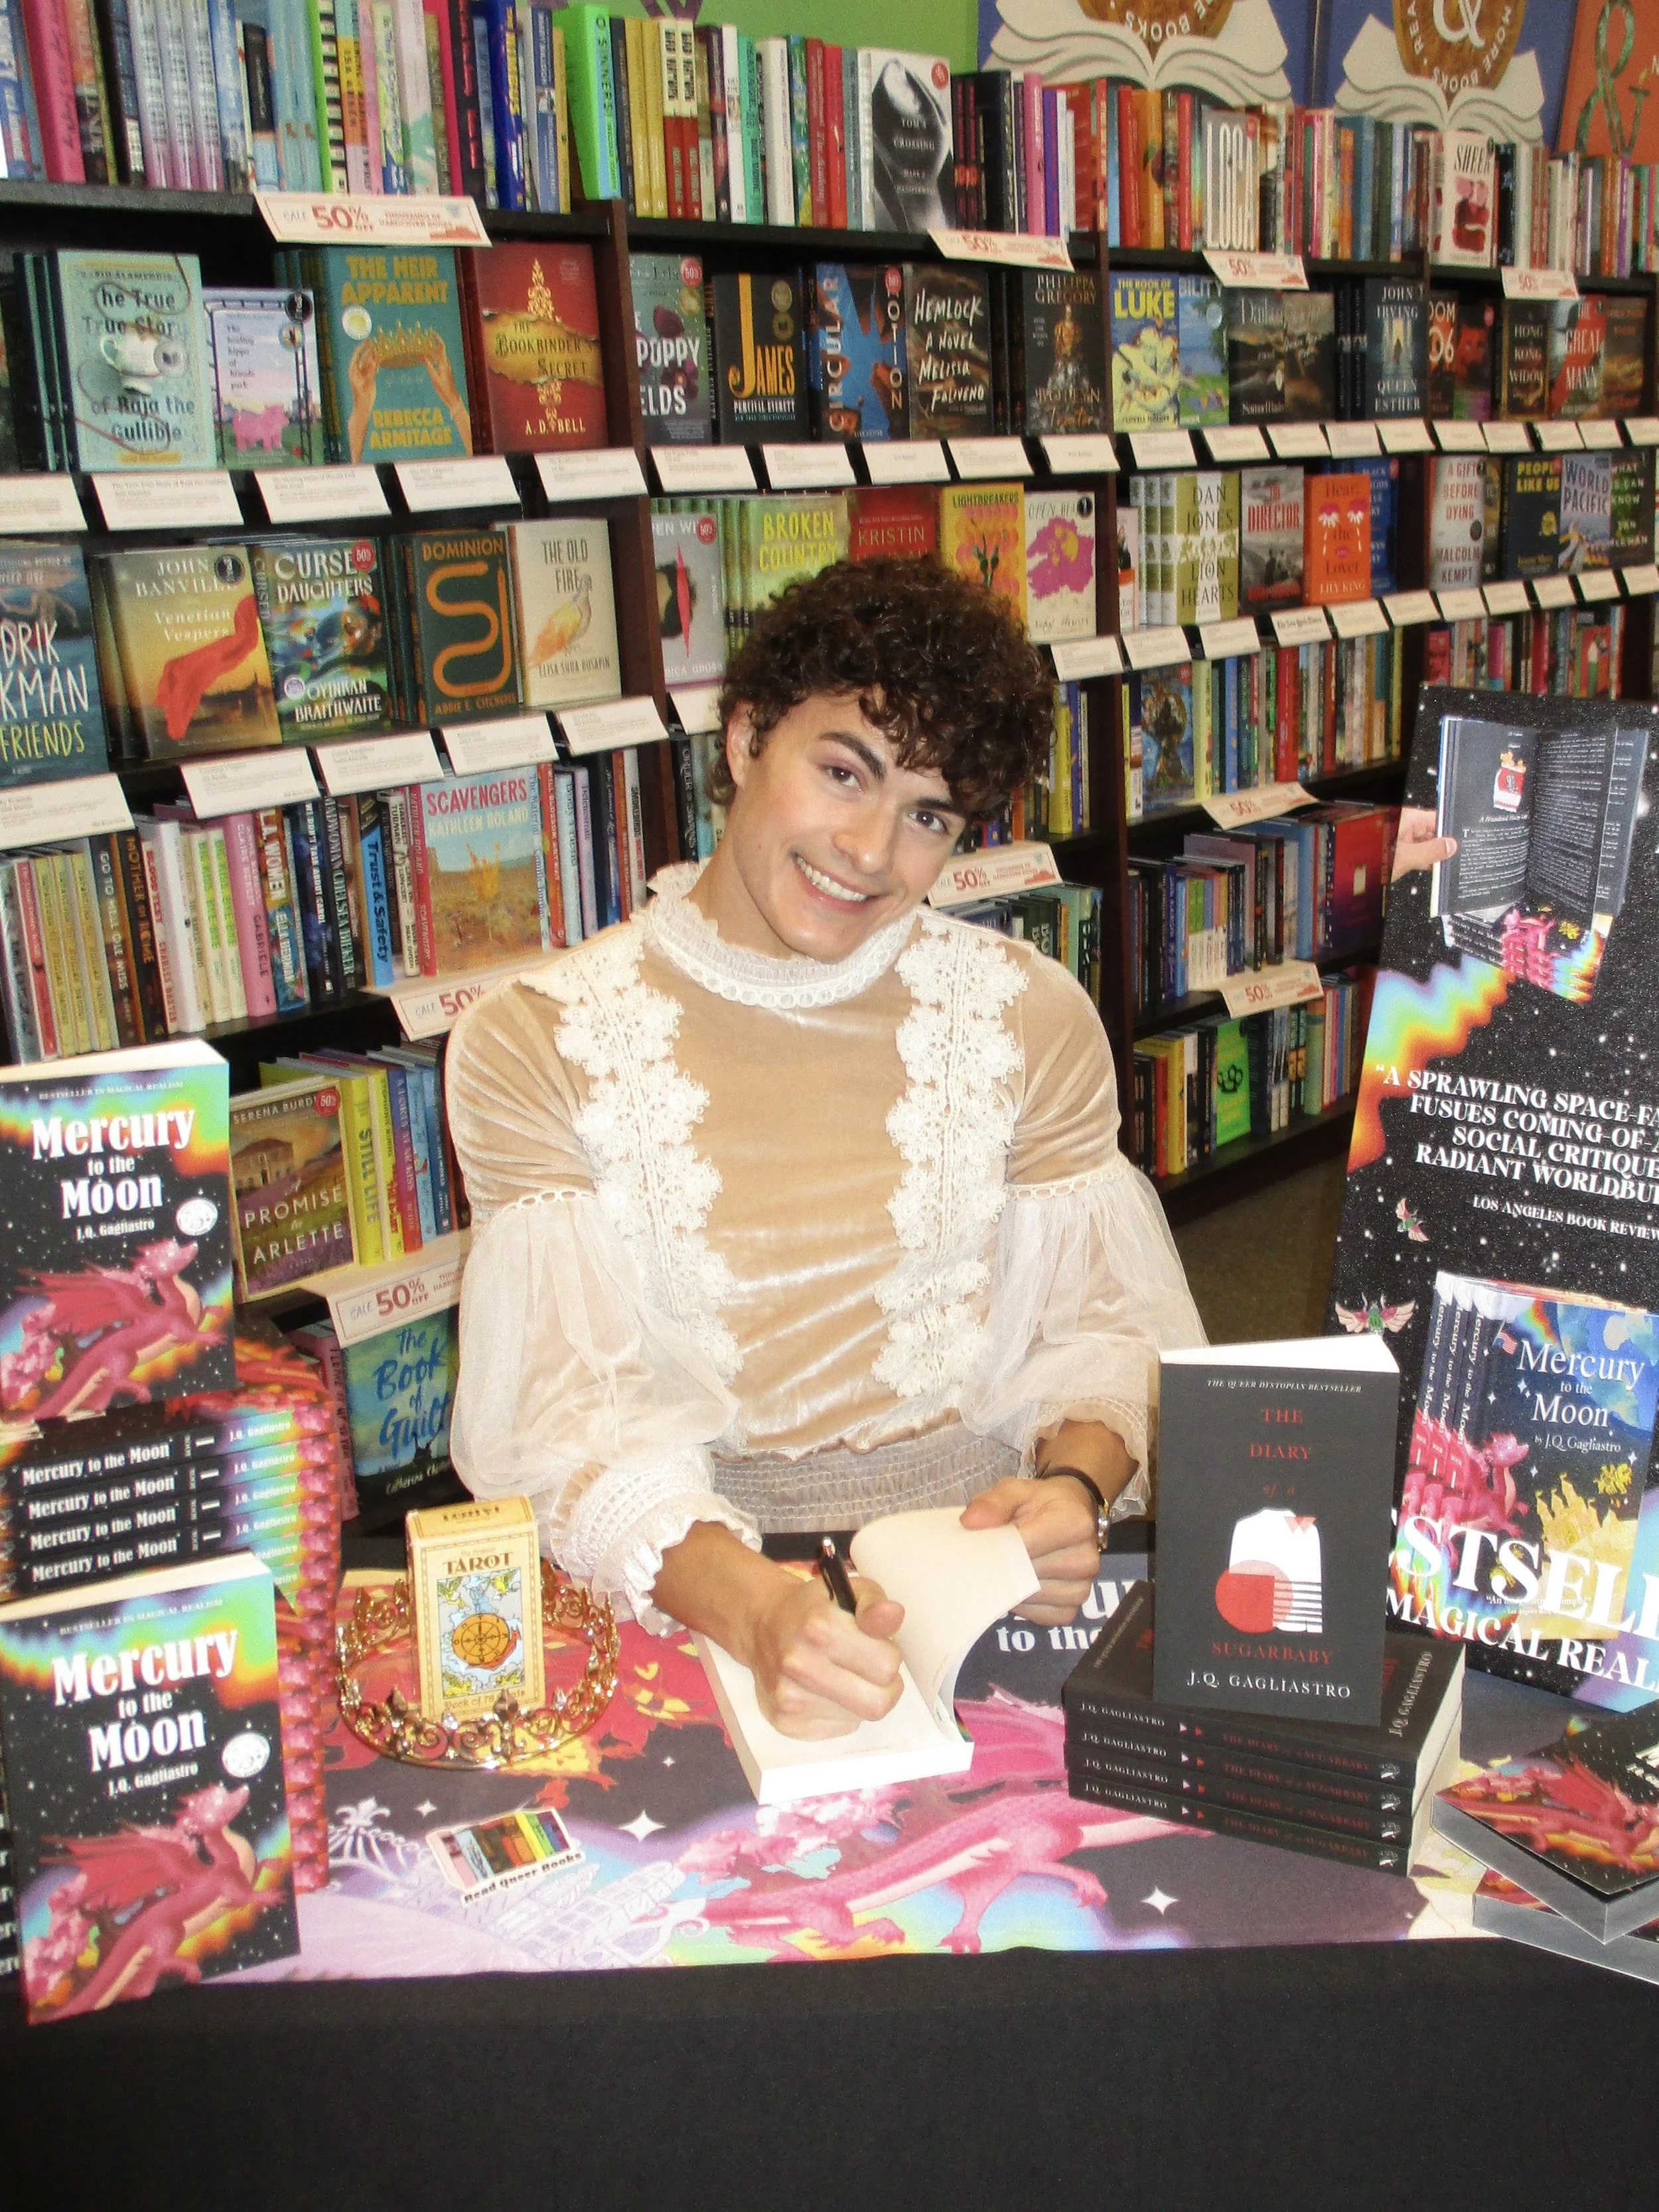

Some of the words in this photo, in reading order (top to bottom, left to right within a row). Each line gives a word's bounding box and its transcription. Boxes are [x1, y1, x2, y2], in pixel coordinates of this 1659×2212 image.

[346, 255, 388, 280] THE
[393, 255, 439, 280] HEIR
[341, 280, 449, 306] APPARENT
[1114, 288, 1176, 320] LUKE
[1382, 285, 1413, 302] JOHN
[913, 287, 984, 327] HEMLOCK
[1376, 304, 1419, 319] IRVING
[728, 271, 796, 399] JAMES
[925, 332, 933, 352] A
[939, 331, 975, 351] NOVEL
[636, 335, 701, 368] POPPY
[538, 357, 587, 378] SECRET
[1508, 369, 1544, 384] WIDOW
[1377, 378, 1418, 396] QUEEN
[166, 396, 196, 415] the
[372, 406, 443, 428] REBECCA
[1374, 397, 1421, 413] ESTHER
[111, 420, 182, 443] Gullible
[369, 426, 452, 450] ARMITAGE
[556, 418, 587, 434] BELL
[952, 492, 1019, 509] LIGHTBREAKERS
[1193, 484, 1226, 506] DAN
[1187, 509, 1234, 530] JONES
[1247, 503, 1300, 534] DIRECTOR
[1445, 504, 1475, 522] DYING
[762, 510, 835, 543] BROKEN
[857, 524, 925, 548] KRISTIN
[421, 536, 504, 562] DOMINION
[541, 539, 564, 565] THE
[566, 538, 589, 563] OLD
[758, 540, 839, 573] COUNTRY
[156, 558, 211, 577] JOHN
[273, 550, 359, 579] CURSE
[1190, 563, 1226, 581] LION
[277, 575, 374, 604] DAUGHTERS
[1181, 585, 1234, 608] HEARTS
[153, 608, 232, 626] Venetian
[163, 628, 230, 644] Vespers
[294, 693, 383, 722] BRAITHWAITE
[425, 778, 528, 817] SCAVENGERS
[368, 841, 381, 889] Trust
[374, 906, 389, 964] Safety
[1407, 1070, 1548, 1110] SPRAWLING
[233, 1104, 279, 1125] SERENA
[1409, 1094, 1497, 1126] FUSUES
[31, 1108, 196, 1160] Mercury
[1452, 1126, 1543, 1160] SOCIAL
[86, 1157, 104, 1177] to
[108, 1155, 135, 1174] the
[358, 1128, 375, 1180] STILL
[1415, 1143, 1527, 1181] RADIANT
[60, 1173, 164, 1220] Moon
[245, 1184, 344, 1230] PROMISE
[1473, 1195, 1499, 1213] LOS
[1502, 1200, 1564, 1224] ANGELES
[1566, 1214, 1608, 1232] BOOK
[98, 1218, 156, 1238] Gagliastro
[253, 1222, 344, 1266] ARLETTE
[376, 1276, 425, 1318] 50%
[411, 1293, 429, 1306] OFF
[396, 1327, 427, 1357] The
[374, 1336, 449, 1402] Book
[1430, 1352, 1437, 1364] to
[1448, 1359, 1455, 1371] to
[1516, 1339, 1646, 1392] Mercury
[1206, 1379, 1225, 1388] THE
[1258, 1381, 1307, 1391] DYSTOPIAN
[1308, 1384, 1362, 1394] BESTSELLER
[1467, 1368, 1473, 1380] to
[409, 1385, 423, 1414] of
[1560, 1380, 1572, 1394] to
[1575, 1380, 1593, 1395] the
[1263, 1408, 1304, 1424] THE
[1531, 1393, 1611, 1428] Moon
[378, 1390, 452, 1461] Guilt
[1249, 1443, 1312, 1460] DIARY
[1567, 1436, 1622, 1454] Gagliastro
[21, 1459, 84, 1487] Mercury
[88, 1455, 102, 1473] to
[104, 1450, 125, 1470] the
[129, 1441, 171, 1465] Moon
[28, 1491, 89, 1521] Mercury
[94, 1489, 108, 1507] to
[109, 1483, 131, 1503] the
[134, 1473, 176, 1498] Moon
[29, 1522, 91, 1552] Mercury
[95, 1520, 109, 1538] to
[111, 1514, 132, 1534] the
[135, 1505, 177, 1529] Moon
[32, 1555, 93, 1583] Mercury
[97, 1552, 111, 1569] to
[113, 1546, 134, 1566] the
[137, 1536, 178, 1559] Moon
[442, 1551, 514, 1576] TAROT
[1385, 1585, 1549, 1662] MAGICAL
[995, 1626, 1036, 1653] to
[1211, 1641, 1334, 1666] SUGARBABY
[51, 1629, 239, 1707] Mercury
[1187, 1669, 1220, 1689] J.Q.
[1228, 1674, 1352, 1700] GAGLIASTRO
[117, 1697, 139, 1720] to
[142, 1690, 173, 1714] the
[443, 1699, 469, 1710] Deck
[470, 1696, 482, 1706] of
[484, 1694, 495, 1704] 78
[1101, 1707, 1165, 1727] GAGLIASTRO
[88, 1710, 207, 1773] Moon
[1103, 1737, 1167, 1757] GAGLIASTRO
[135, 1761, 199, 1789] Gagliastro
[1105, 1763, 1169, 1784] GAGLIASTRO
[1104, 1788, 1168, 1809] GAGLIASTRO
[464, 1881, 497, 1904] Read
[499, 1868, 538, 1889] Queer
[541, 1852, 583, 1873] Books
